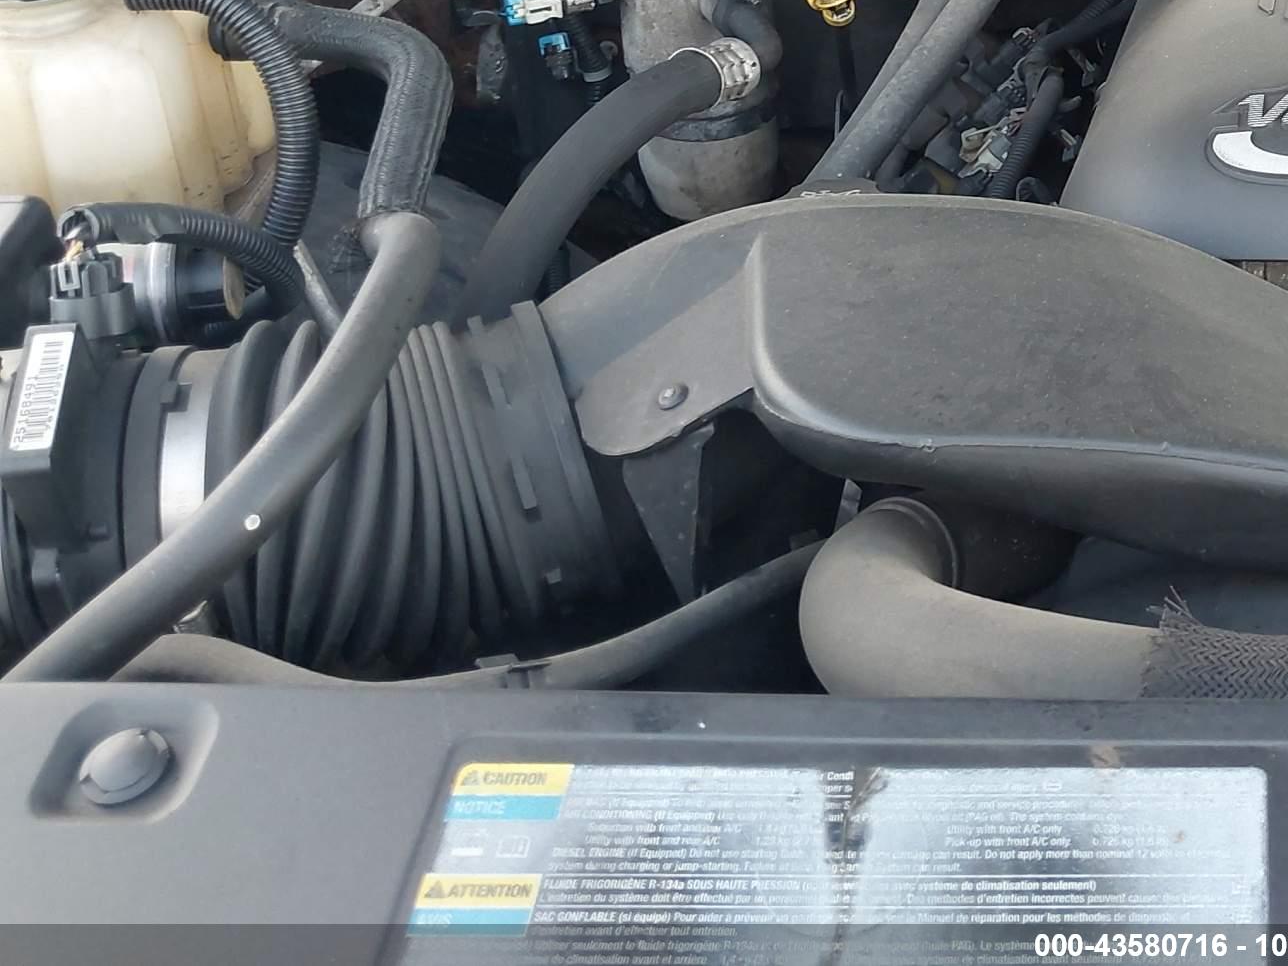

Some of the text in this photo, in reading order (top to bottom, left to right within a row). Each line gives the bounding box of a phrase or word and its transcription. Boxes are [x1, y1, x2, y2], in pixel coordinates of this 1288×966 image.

[483, 771, 548, 786] CAUTION
[453, 801, 506, 815] NOTICE
[1000, 850, 1016, 859] not
[447, 884, 530, 899] ATTENTION
[648, 879, 685, 890] R-134a
[687, 879, 714, 890] SOUS
[715, 879, 748, 890] HAUTE
[976, 880, 1040, 891] climatisation
[1041, 880, 1097, 893] seulement)
[651, 893, 670, 903] doit
[1031, 894, 1085, 904] incorrectes
[534, 911, 555, 922] SAC
[557, 911, 617, 922] GONFLABLE
